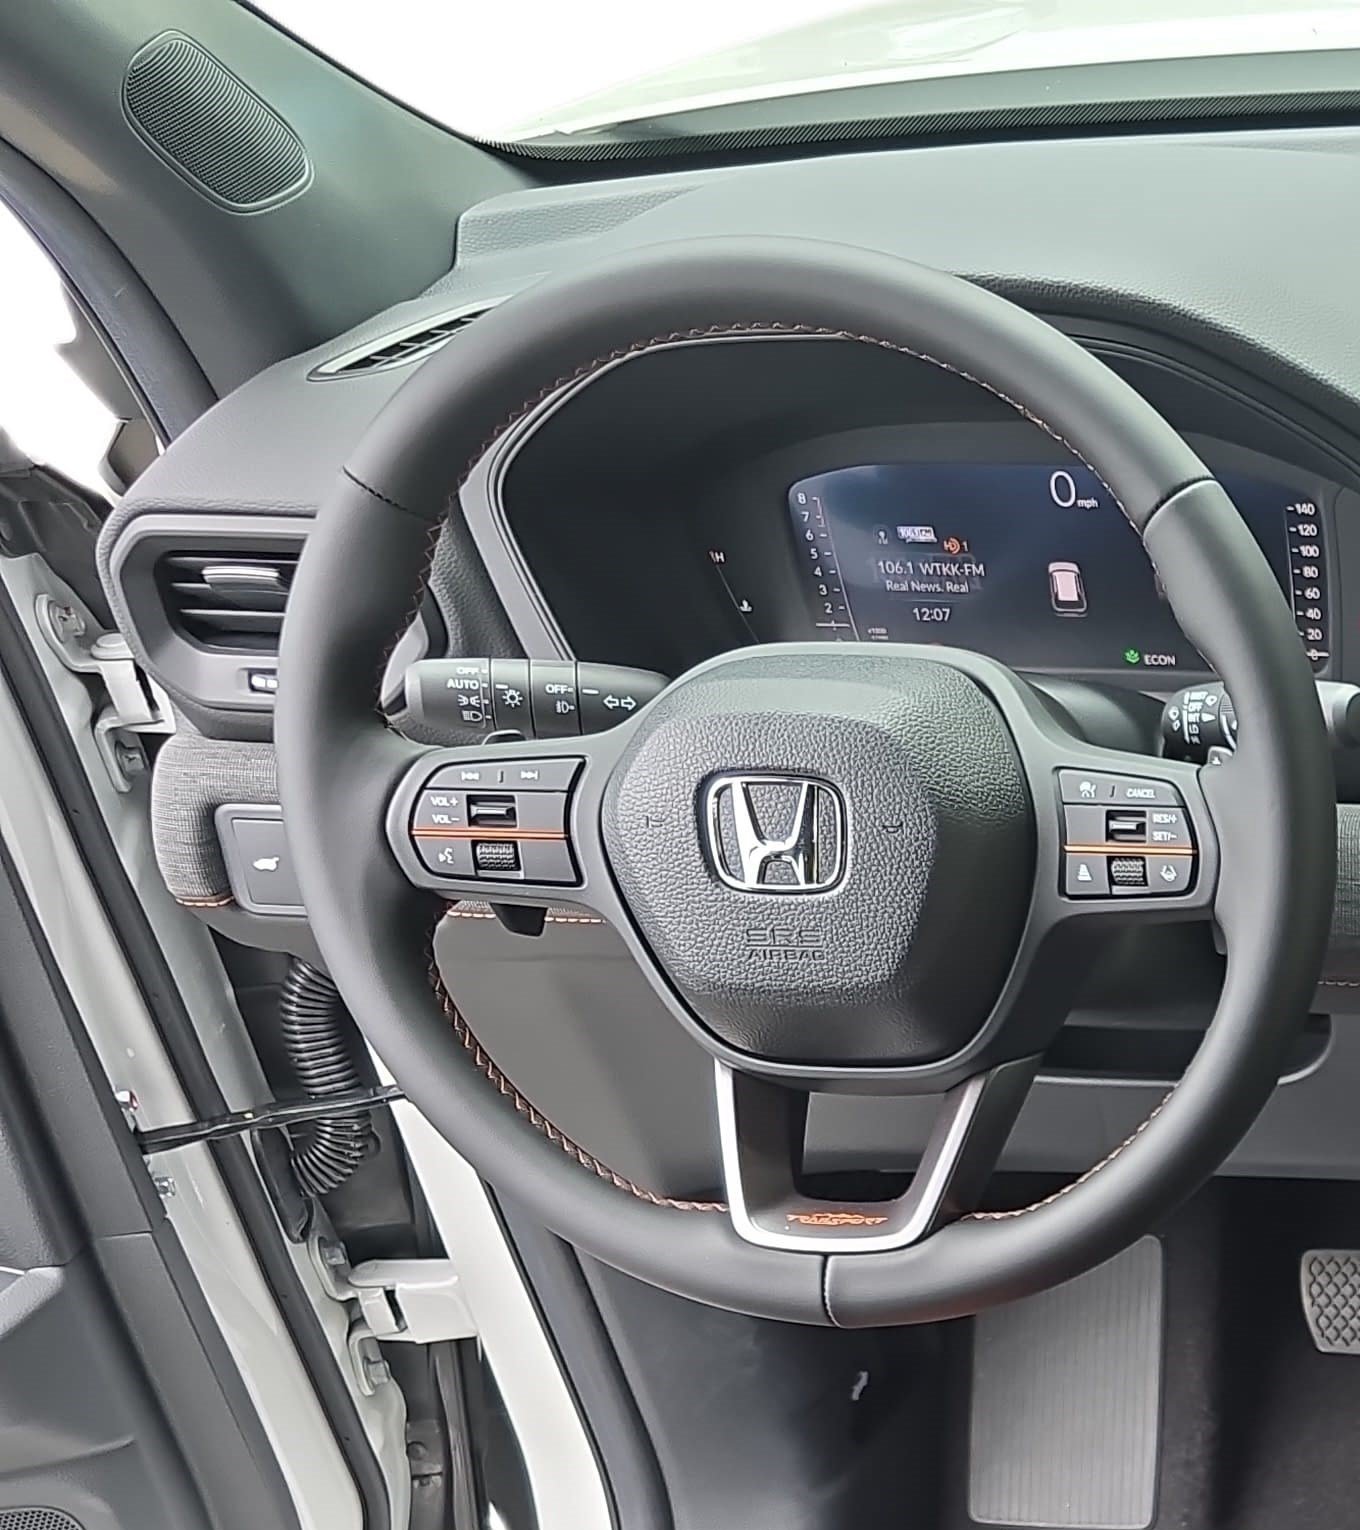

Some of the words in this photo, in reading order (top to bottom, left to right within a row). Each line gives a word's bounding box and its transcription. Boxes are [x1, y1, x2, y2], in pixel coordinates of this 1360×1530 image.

[1049, 470, 1077, 508] 0
[1076, 498, 1099, 510] mph
[797, 493, 807, 505] 8
[1295, 502, 1316, 516] 140
[801, 511, 809, 522] 7
[805, 529, 814, 541] 6
[1297, 524, 1318, 537] 120
[810, 548, 818, 560] 5
[1299, 545, 1320, 558] 100
[813, 566, 822, 577] 4
[878, 561, 914, 575] 106.1
[919, 562, 985, 577] WTKK-FM
[1302, 566, 1319, 578] 80
[818, 584, 828, 596] 3
[885, 580, 909, 592] Real
[911, 581, 944, 592] News.
[946, 581, 969, 593] Real
[1304, 587, 1321, 600] 60
[824, 602, 833, 614] 2
[912, 607, 951, 621] 12:07
[1305, 608, 1322, 620] 40
[1306, 628, 1323, 640] 20
[1143, 653, 1177, 666] ECON
[455, 666, 479, 675] OFF
[447, 679, 480, 690] AUTO
[545, 684, 568, 694] OFF
[1126, 788, 1156, 798] CANCEL
